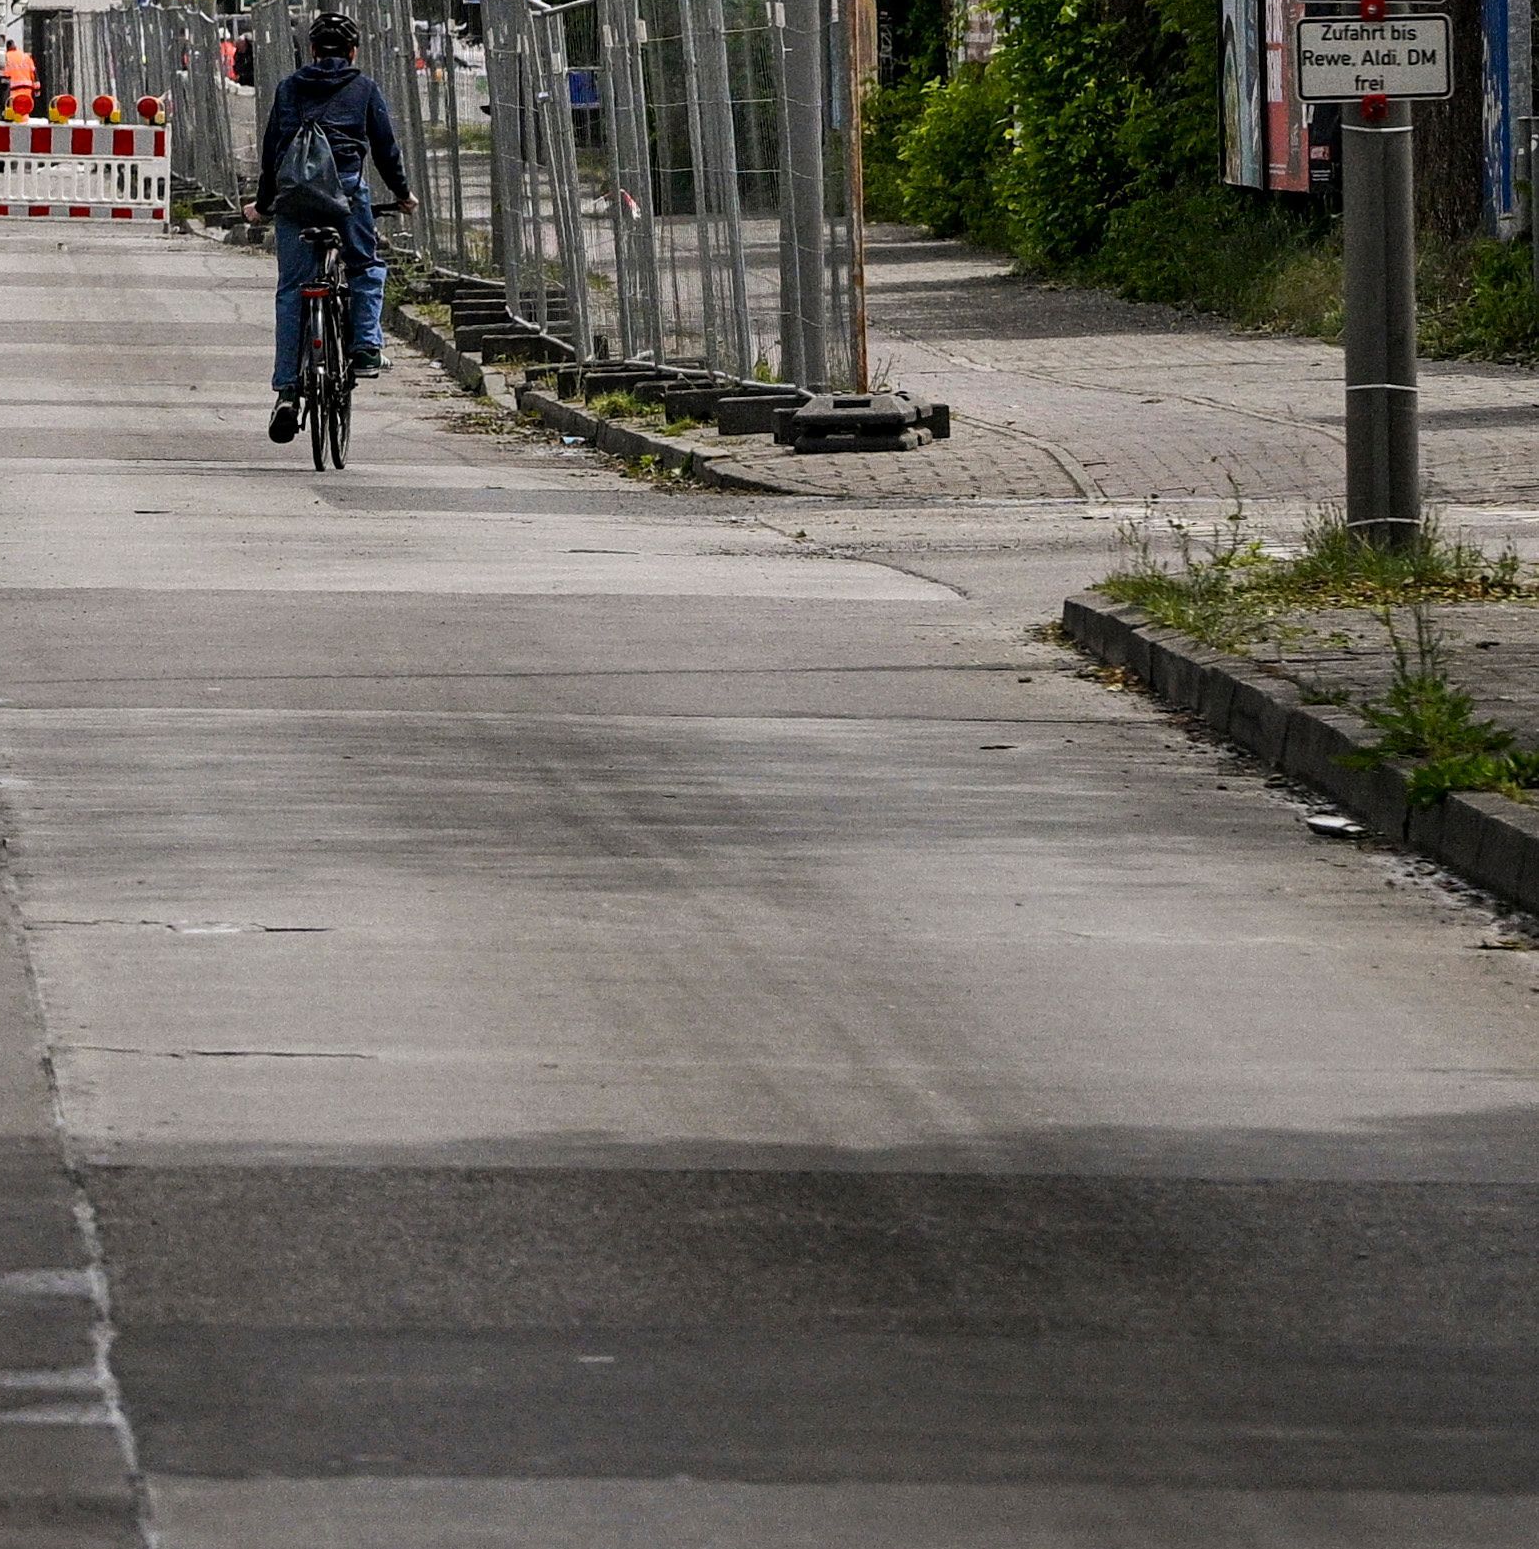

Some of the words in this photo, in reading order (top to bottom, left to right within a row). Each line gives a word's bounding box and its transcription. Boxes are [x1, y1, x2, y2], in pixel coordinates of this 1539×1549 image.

[1321, 24, 1385, 41] Zufahrt
[1390, 24, 1417, 41] bis
[1407, 48, 1437, 66] DM
[1354, 74, 1385, 91] frei
